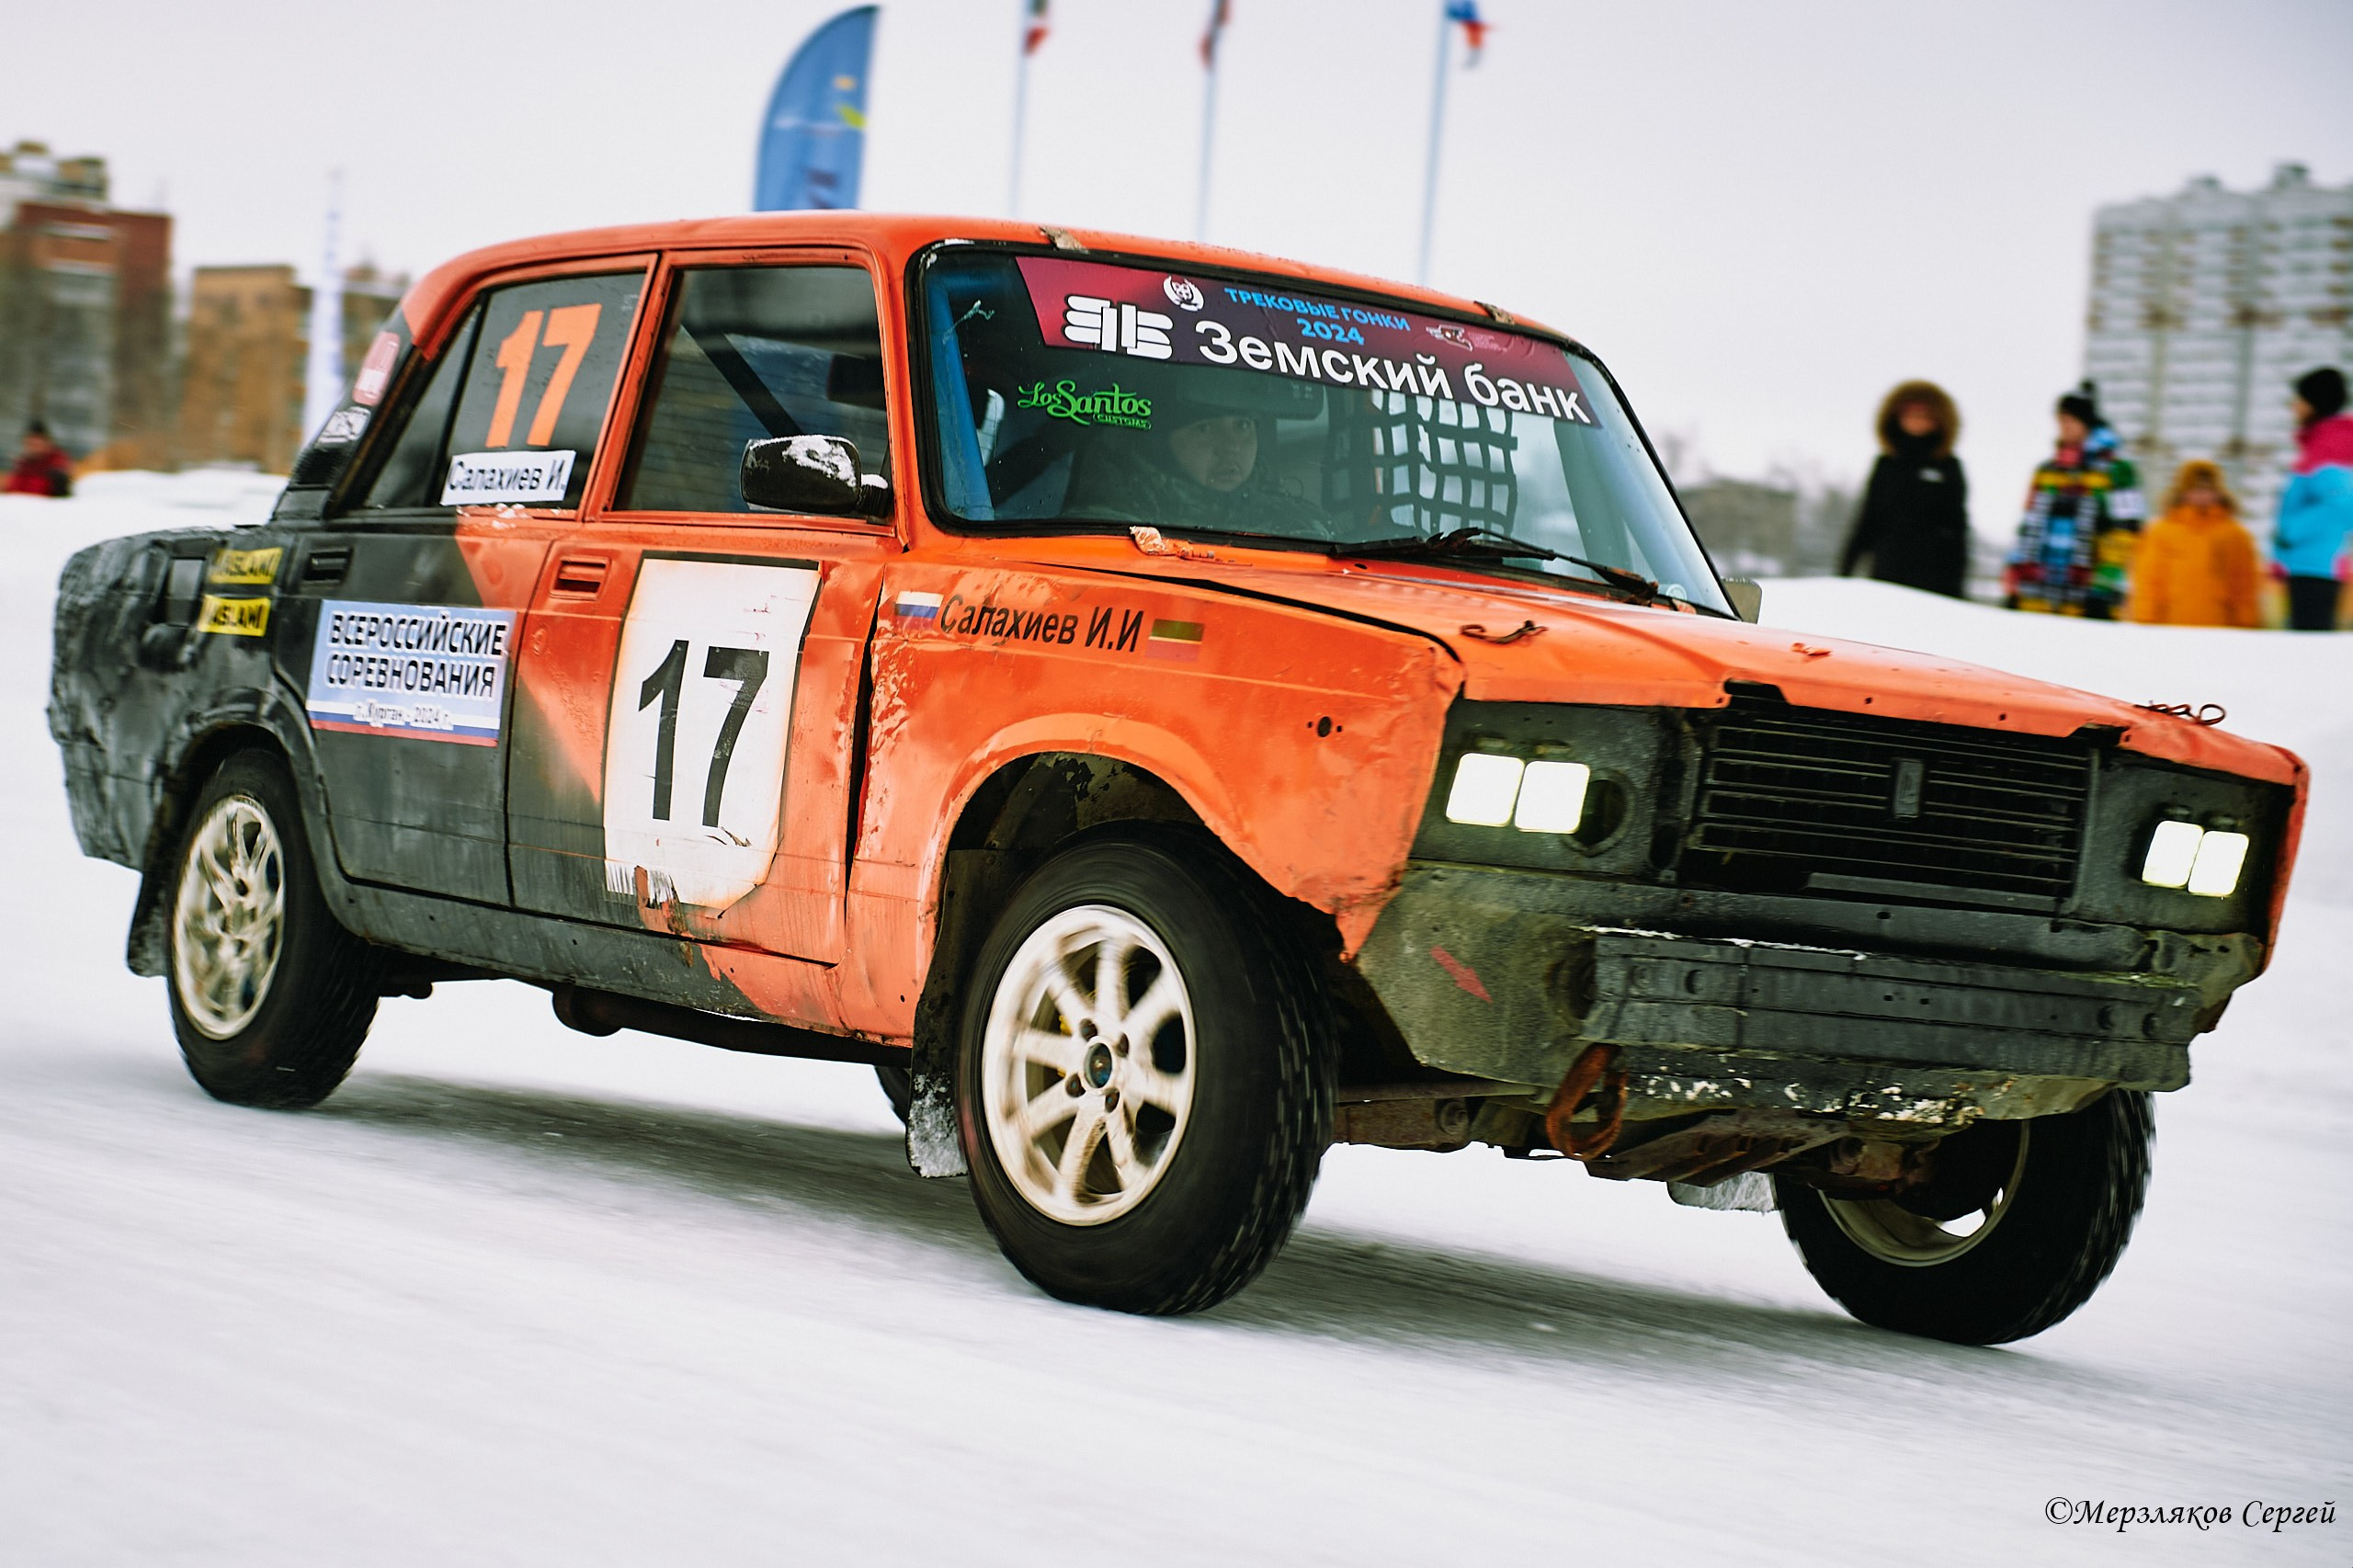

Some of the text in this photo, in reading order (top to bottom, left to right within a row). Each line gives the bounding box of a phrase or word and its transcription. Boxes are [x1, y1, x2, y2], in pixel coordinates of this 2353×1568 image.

[1224, 288, 1411, 332] ТРЕКОВЫЕ ГОНКИ
[1296, 318, 1365, 346] 2024
[485, 303, 602, 448] 17
[1195, 320, 1592, 426] Земский банк
[1047, 380, 1152, 426] Santos
[331, 609, 506, 656] ВСЕРОССИЙСКИЕ
[940, 594, 1144, 653] Салахиев И.И
[327, 653, 496, 698] СОРЕВНОВАНИЯ
[638, 640, 769, 827] 17
